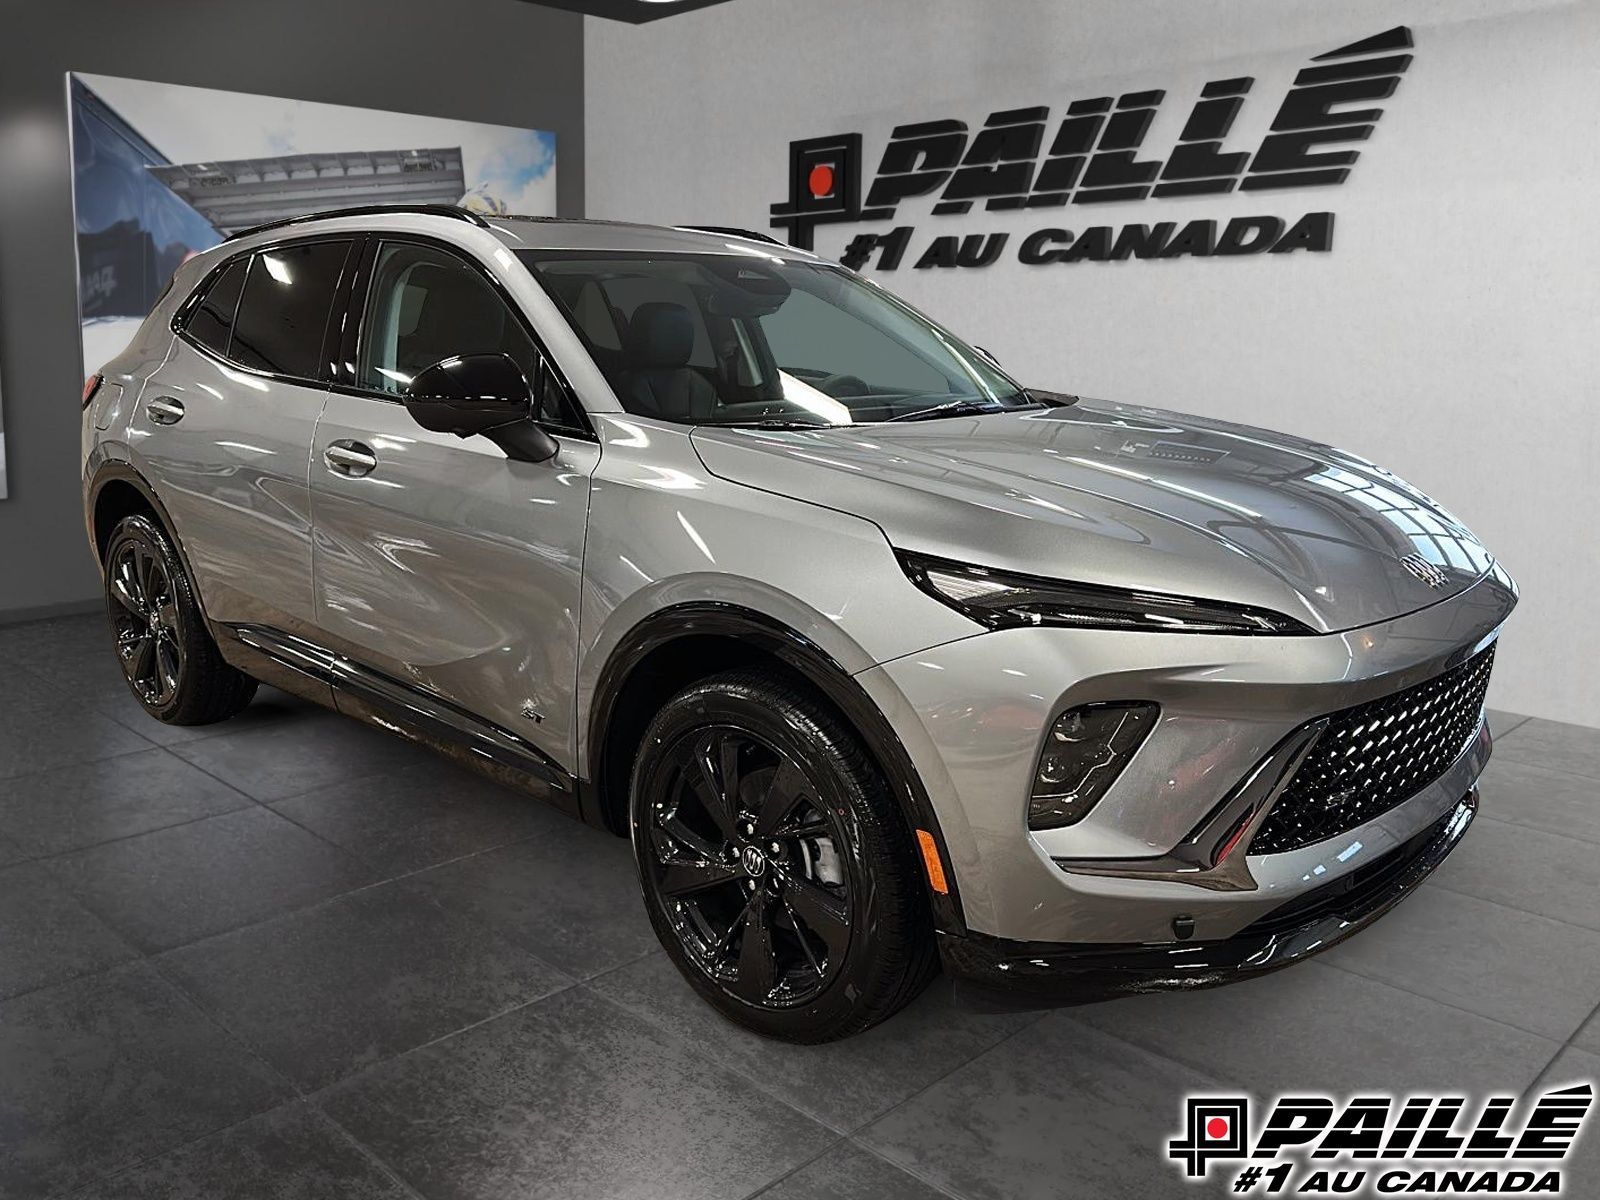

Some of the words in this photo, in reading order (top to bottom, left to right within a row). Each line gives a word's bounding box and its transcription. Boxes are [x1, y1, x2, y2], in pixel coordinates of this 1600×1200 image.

[861, 25, 1414, 219] PAILLÉ
[839, 226, 915, 271] #1
[913, 232, 1009, 268] AU
[1017, 211, 1335, 265] CANADA
